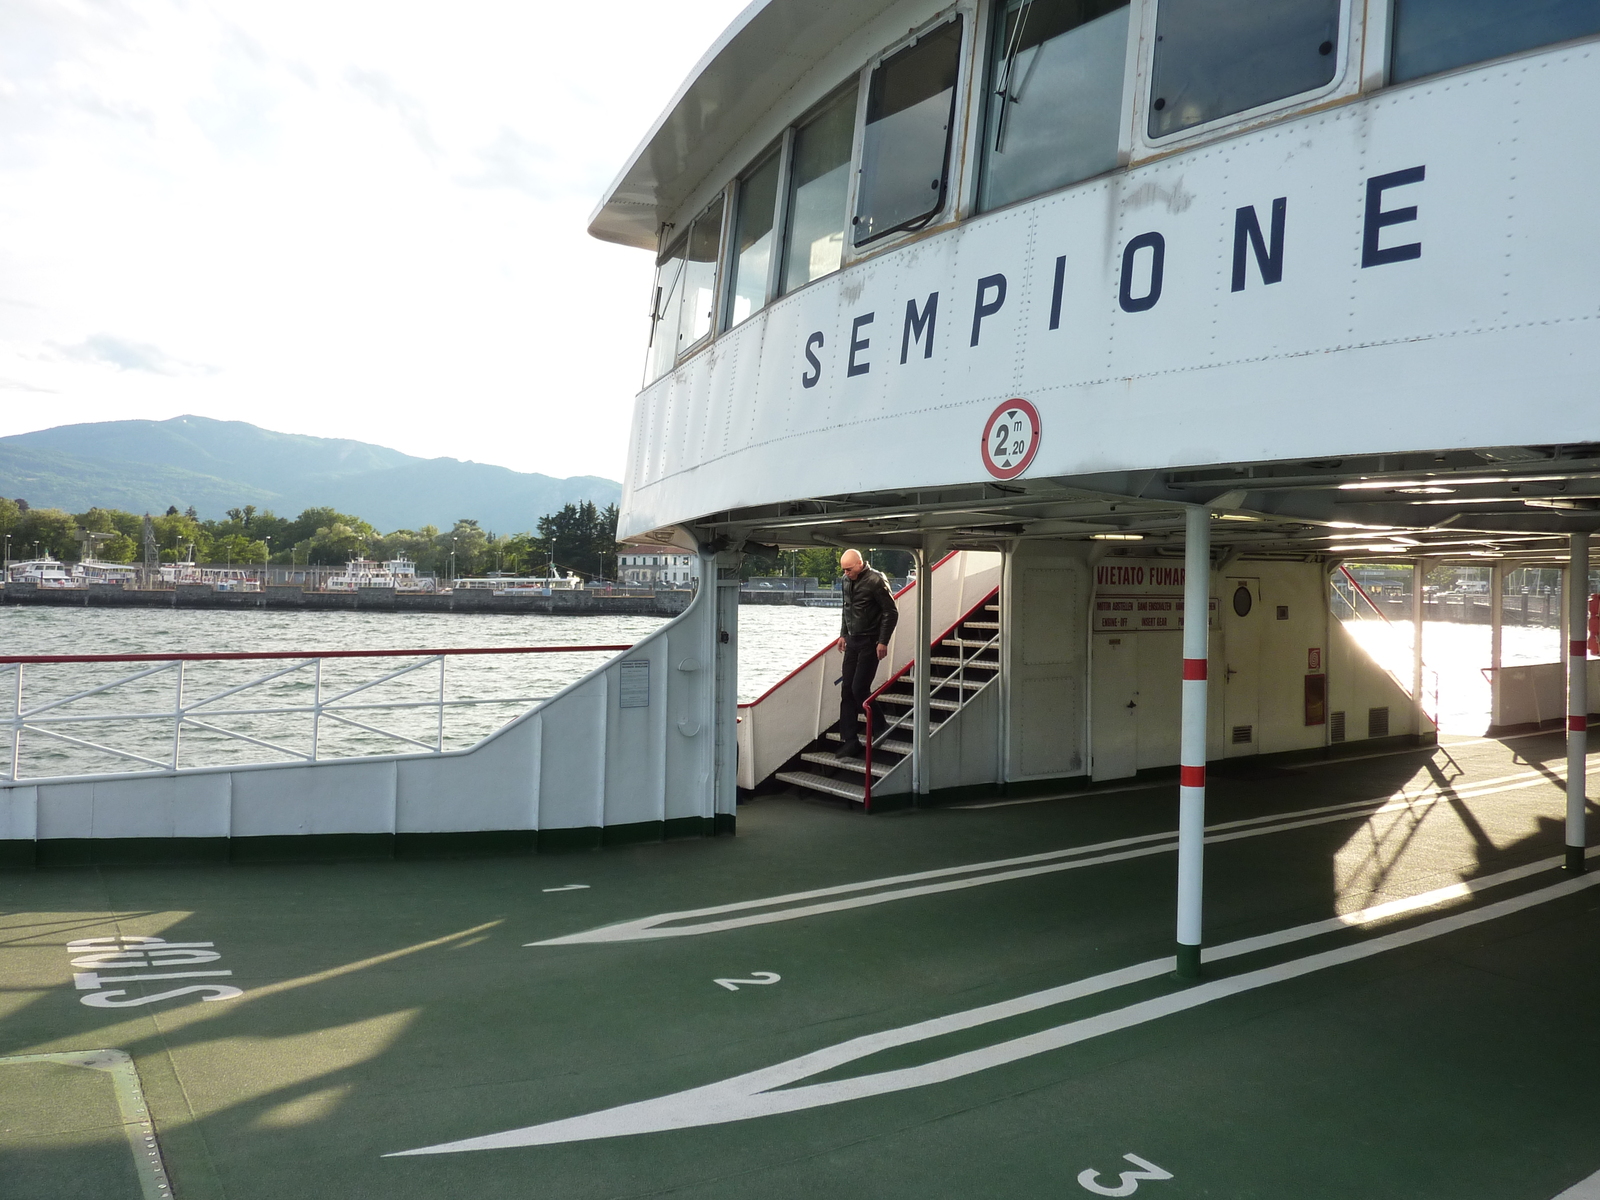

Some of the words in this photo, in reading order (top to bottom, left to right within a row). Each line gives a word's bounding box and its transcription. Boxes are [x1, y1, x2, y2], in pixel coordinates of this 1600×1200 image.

[802, 164, 1426, 389] SEMPIONE
[1097, 566, 1144, 585] VIETATO
[1149, 567, 1185, 586] FUMAR
[542, 884, 590, 892] 1
[66, 936, 244, 1008] STOP
[713, 971, 781, 991] 2
[1077, 1152, 1174, 1197] 3
